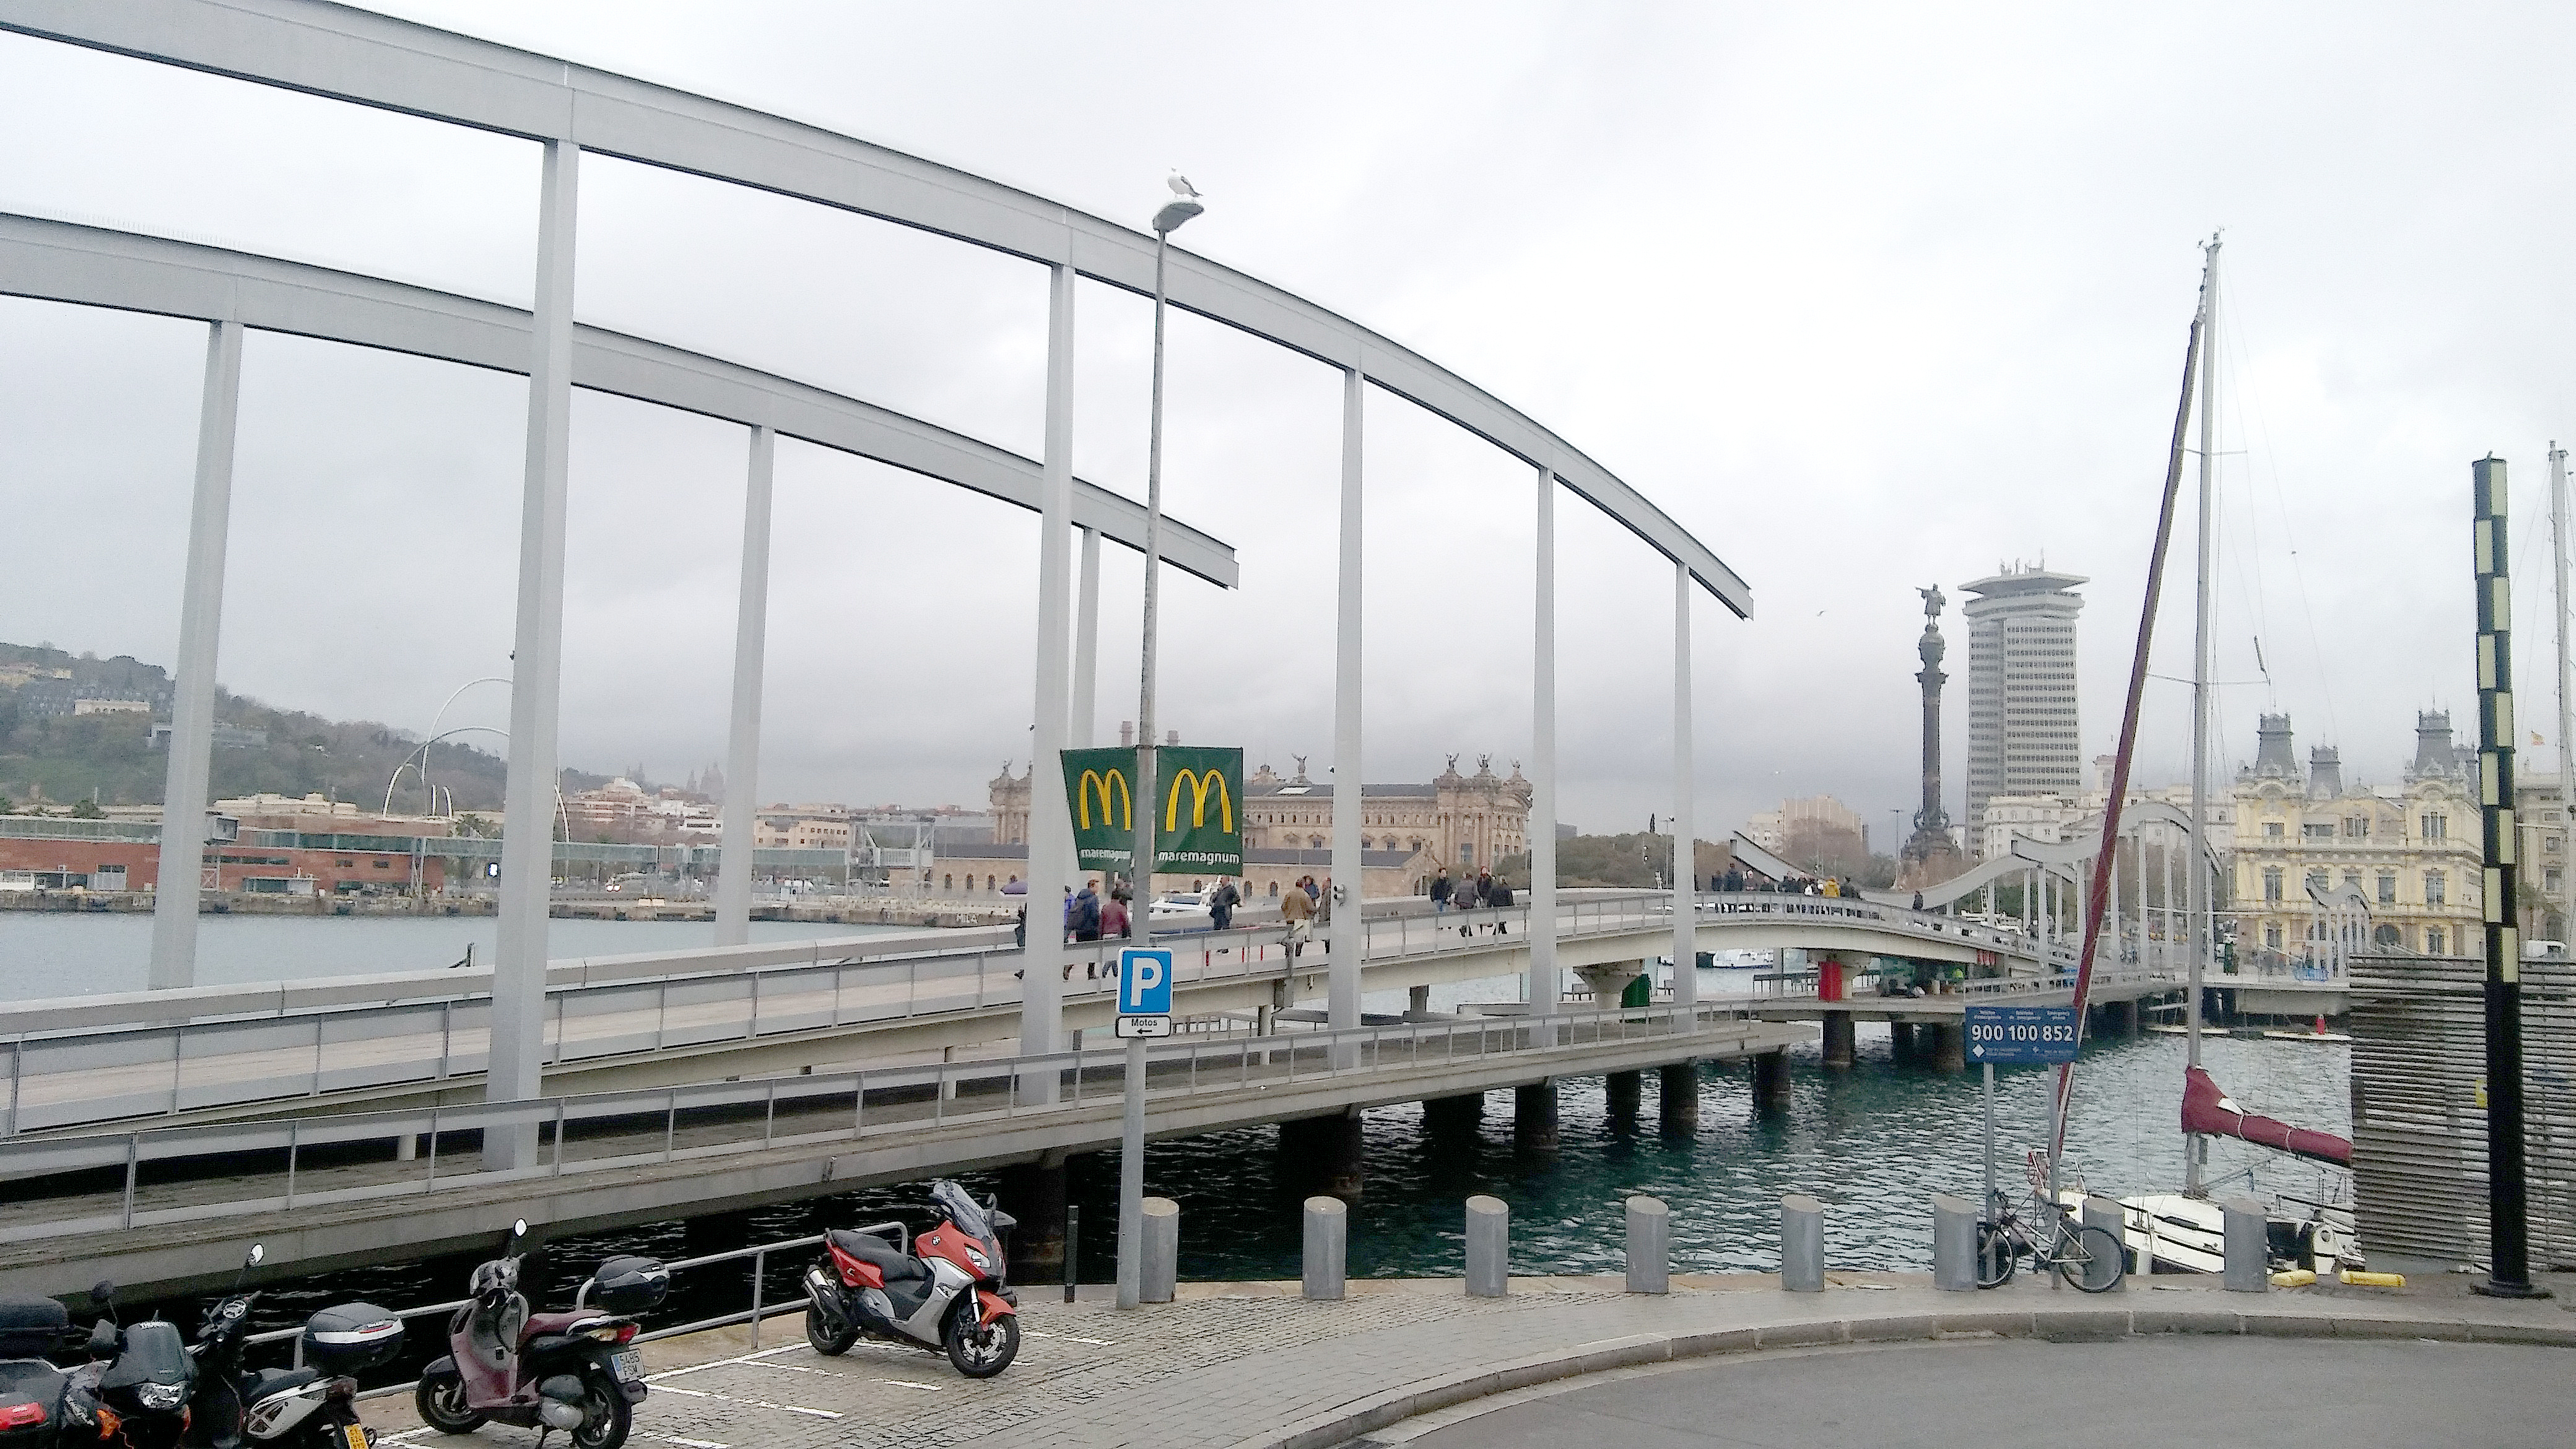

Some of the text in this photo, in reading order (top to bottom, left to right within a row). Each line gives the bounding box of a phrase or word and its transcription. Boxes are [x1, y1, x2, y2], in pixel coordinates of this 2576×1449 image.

[1158, 851, 1240, 864] maremagnum
[1131, 957, 1164, 1006] P
[1131, 1018, 1157, 1026] Motos
[1972, 1024, 2073, 1042] 900 100 852
